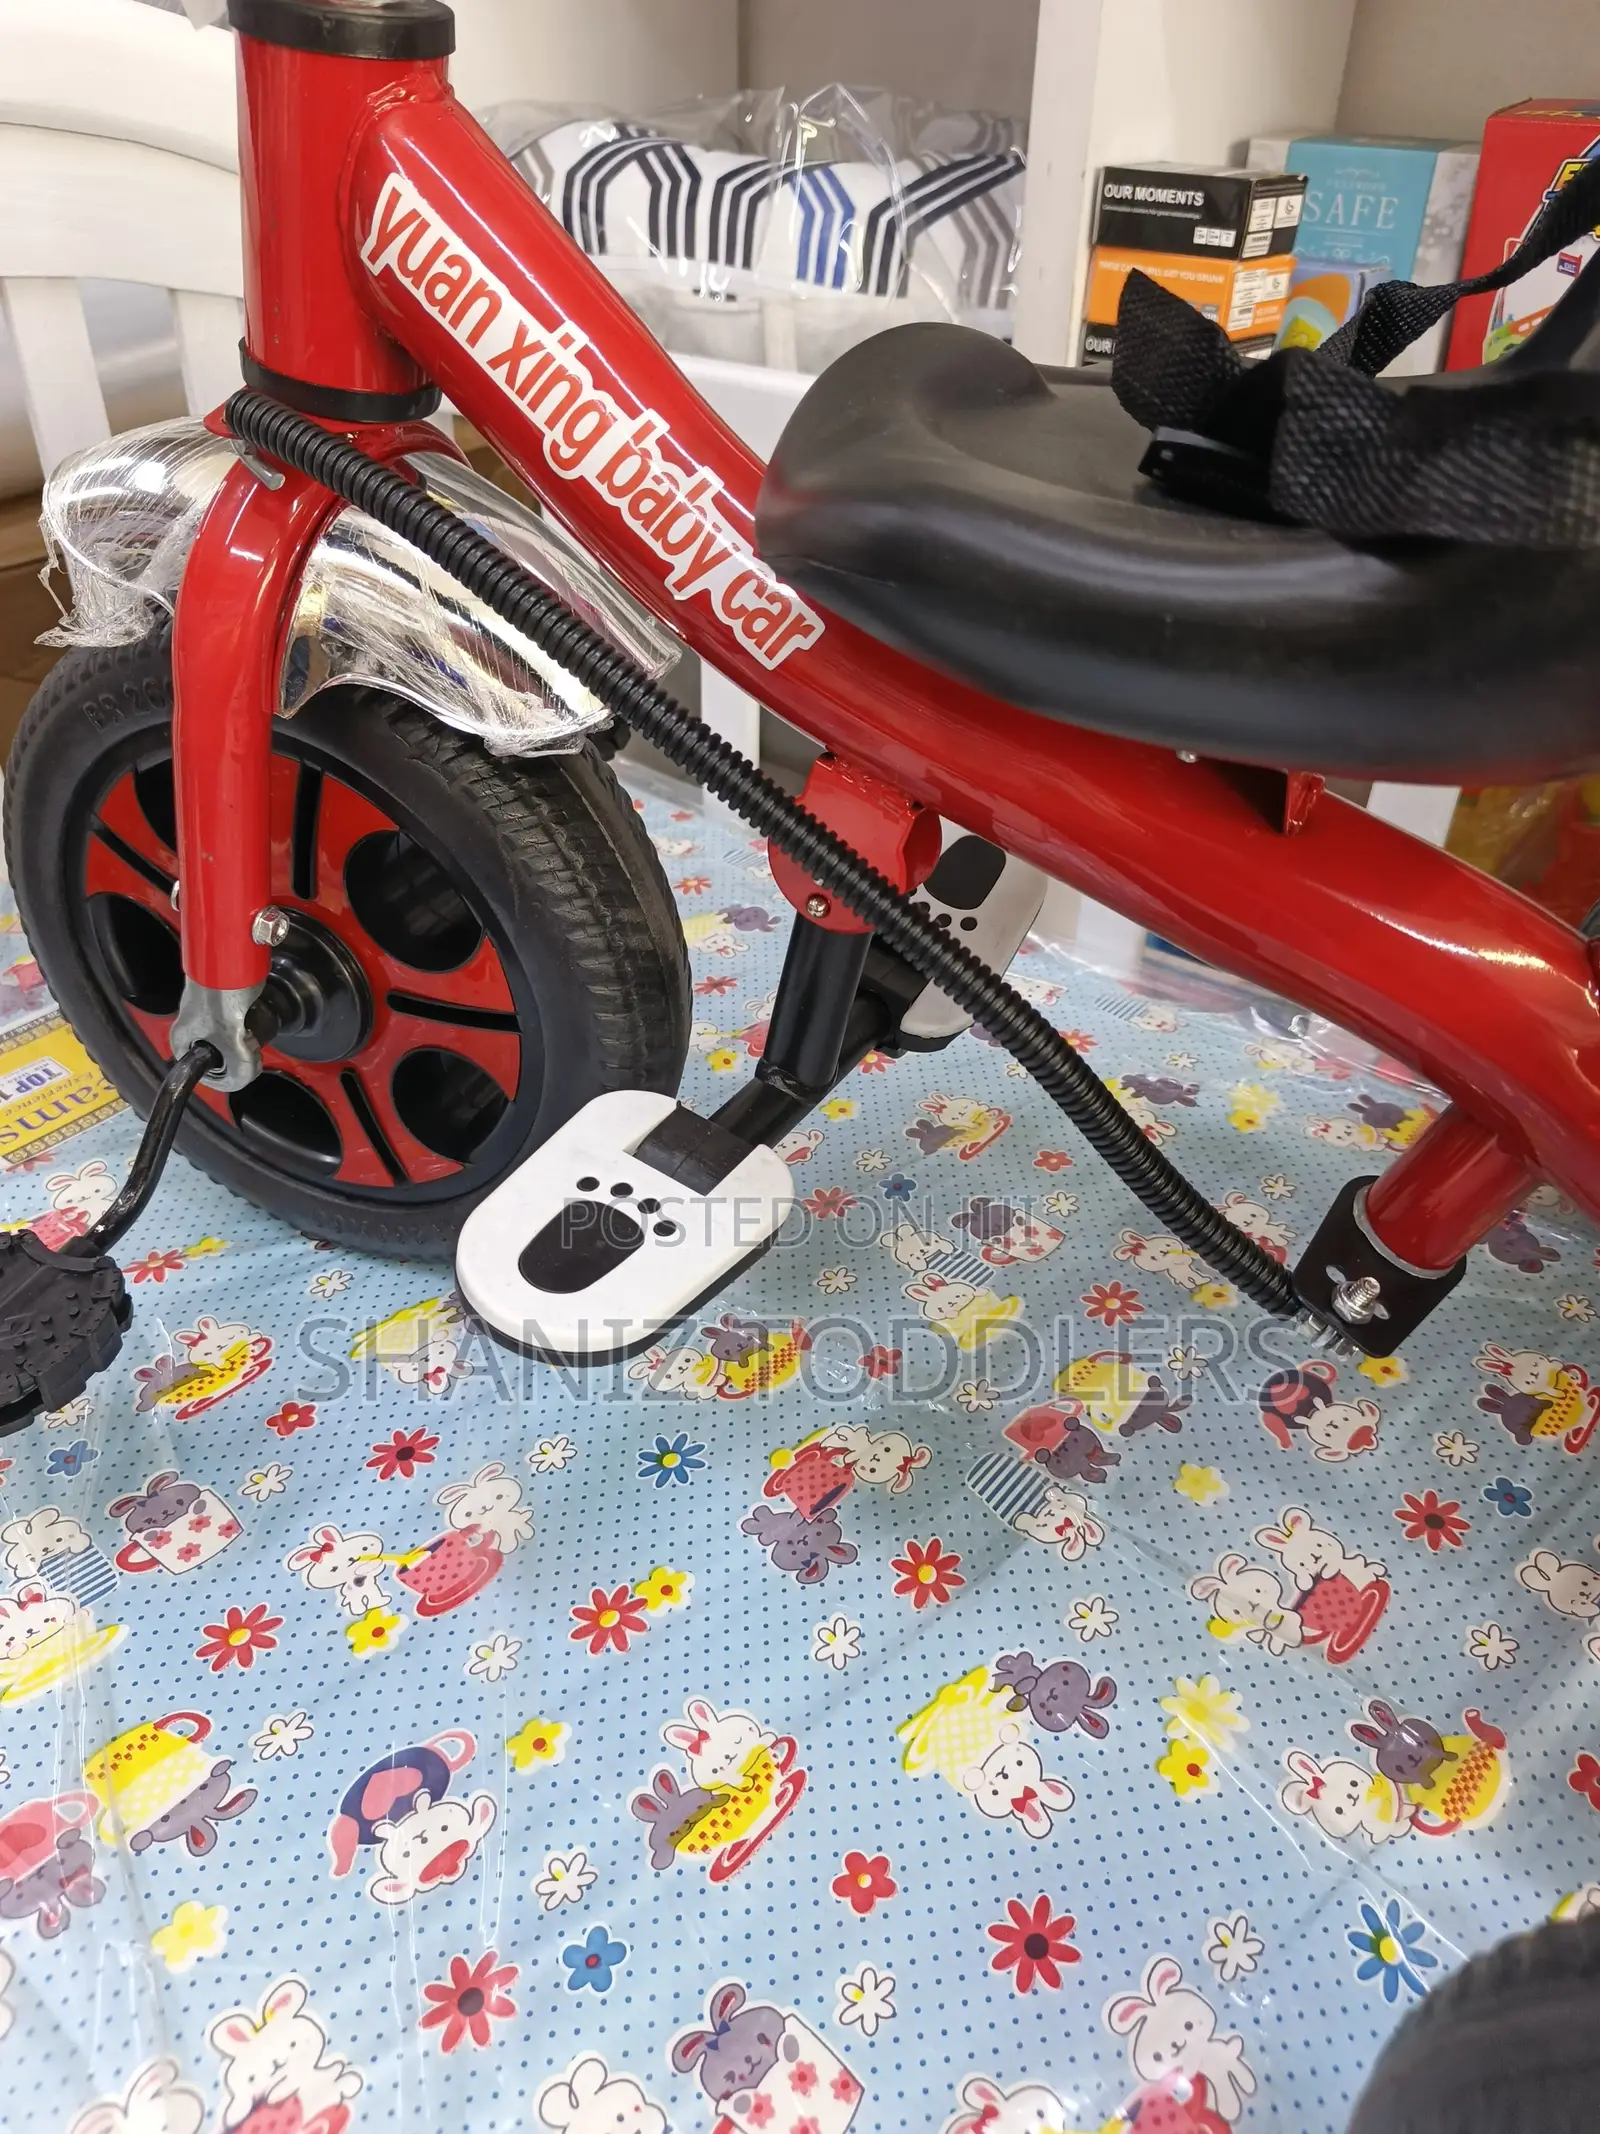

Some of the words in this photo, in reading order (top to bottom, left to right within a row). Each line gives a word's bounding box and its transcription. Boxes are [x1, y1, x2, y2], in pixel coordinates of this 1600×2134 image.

[1104, 183, 1134, 200] OUR
[1134, 186, 1205, 207] MOMENTS
[1303, 190, 1399, 230] SAFE
[1085, 335, 1113, 354] OUR
[366, 183, 504, 352] yuan
[485, 319, 620, 472] xing
[595, 416, 739, 594] baby
[720, 565, 817, 662] car
[15, 1066, 64, 1095] TOP
